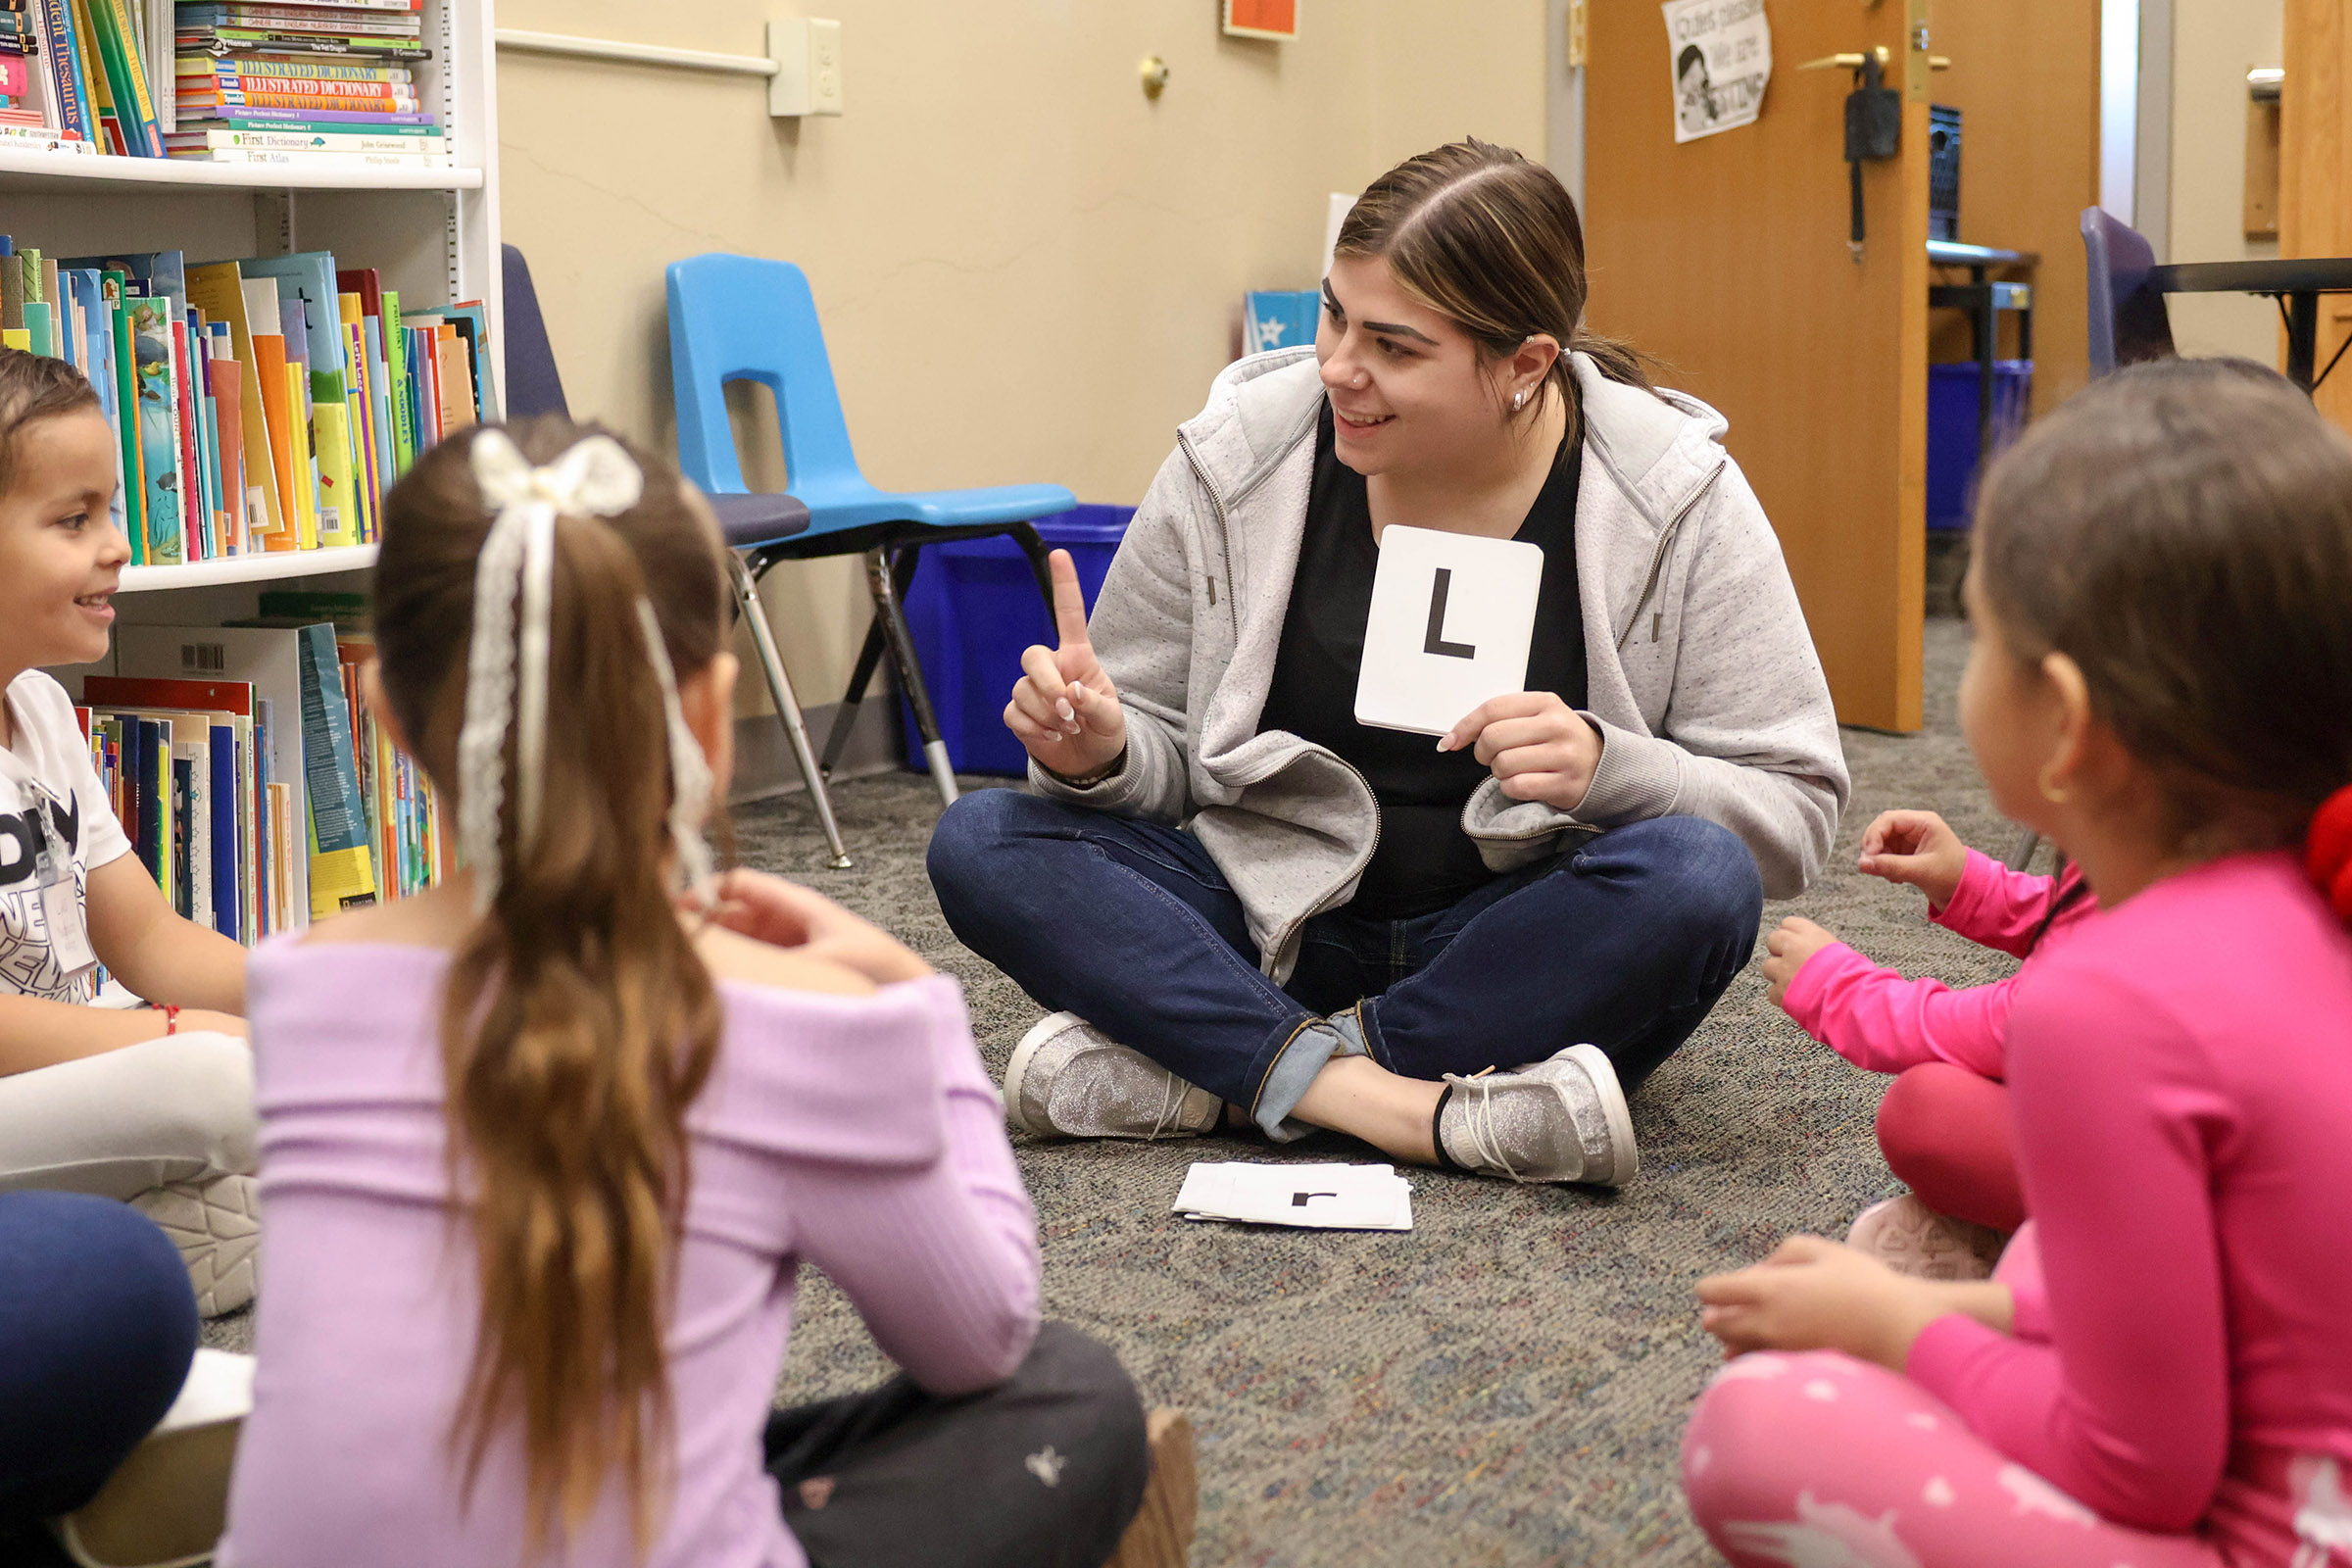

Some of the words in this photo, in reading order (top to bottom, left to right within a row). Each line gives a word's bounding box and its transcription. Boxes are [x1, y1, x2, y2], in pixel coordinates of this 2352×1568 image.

[242, 60, 315, 77] ILLUSTRATED
[317, 65, 377, 80] DICTIONARY
[55, 41, 79, 124] Thesaurus
[245, 76, 318, 95] ILLUSTRATED
[319, 79, 383, 97] DICTIONARY
[251, 93, 323, 110] ILLUSTRATED
[325, 97, 386, 112] DICTIONARY
[242, 132, 264, 145] First
[267, 135, 309, 149] Dictionary
[247, 151, 268, 163] First
[270, 152, 290, 164] Atlas
[1423, 566, 1476, 661] L
